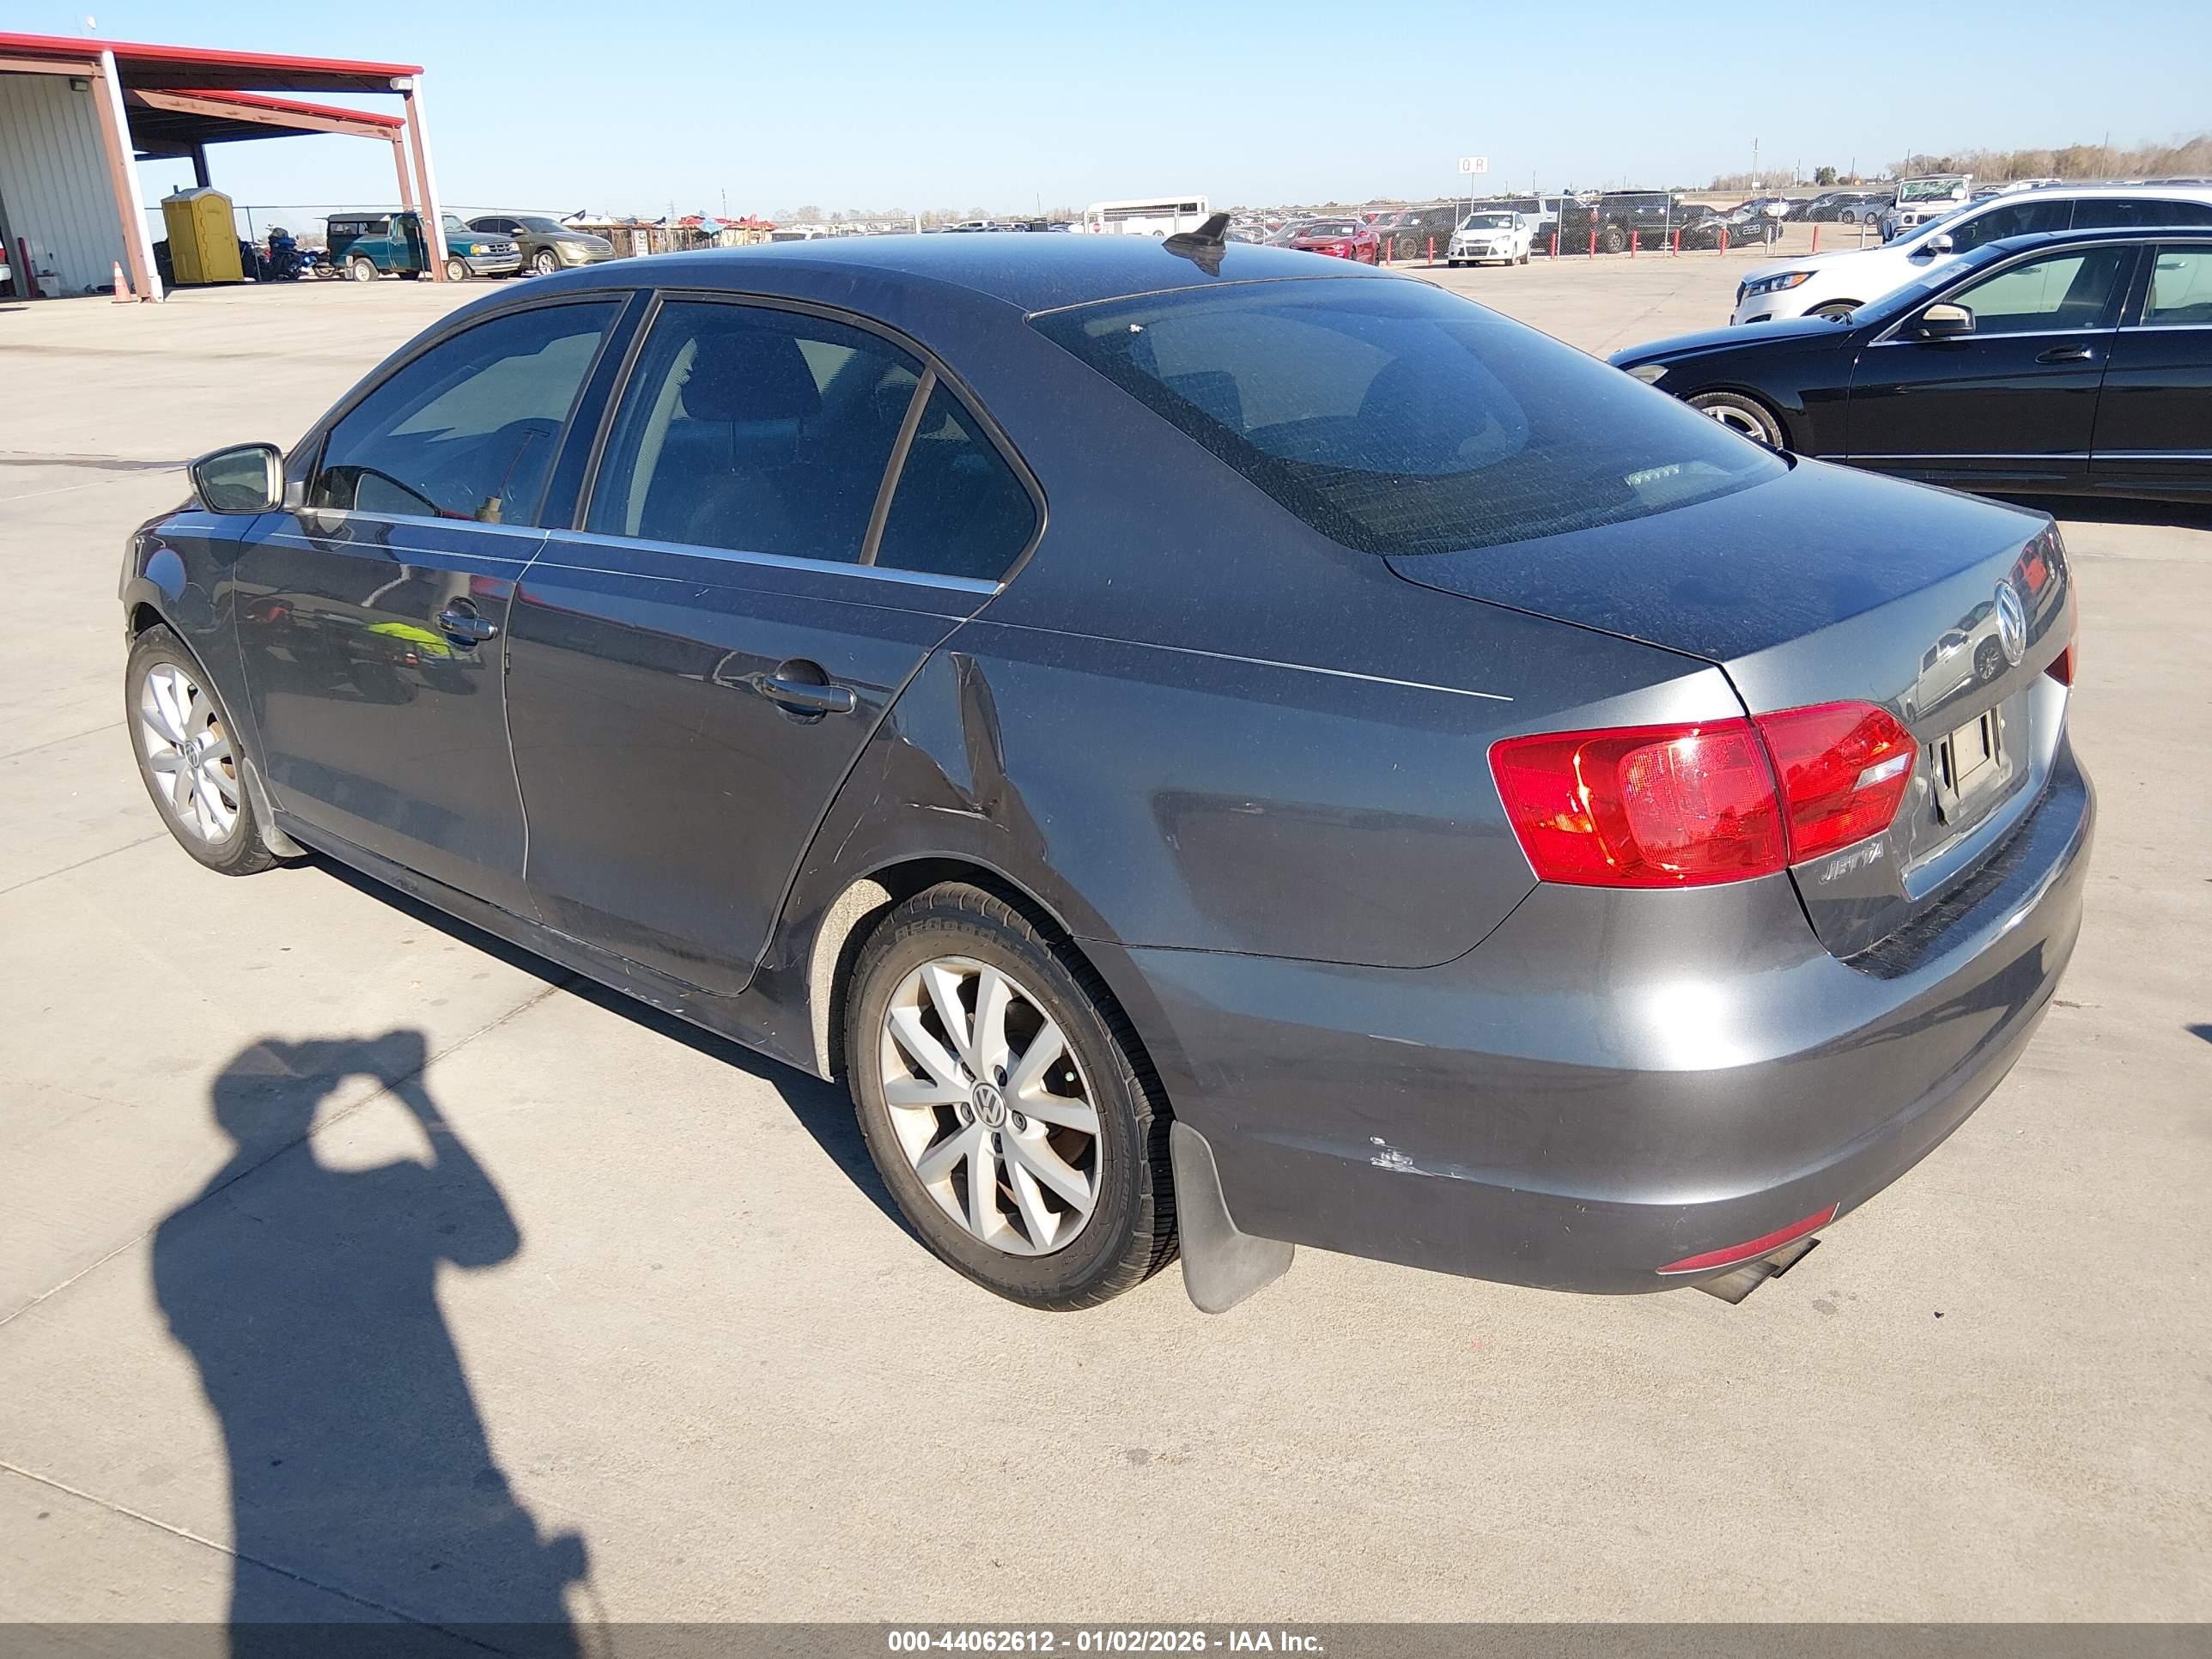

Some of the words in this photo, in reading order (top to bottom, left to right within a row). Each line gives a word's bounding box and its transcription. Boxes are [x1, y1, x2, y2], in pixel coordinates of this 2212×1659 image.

[1463, 159, 1470, 172] Q
[1477, 159, 1484, 172] R
[1820, 841, 1884, 885] JETTA
[973, 1083, 1006, 1127] VW
